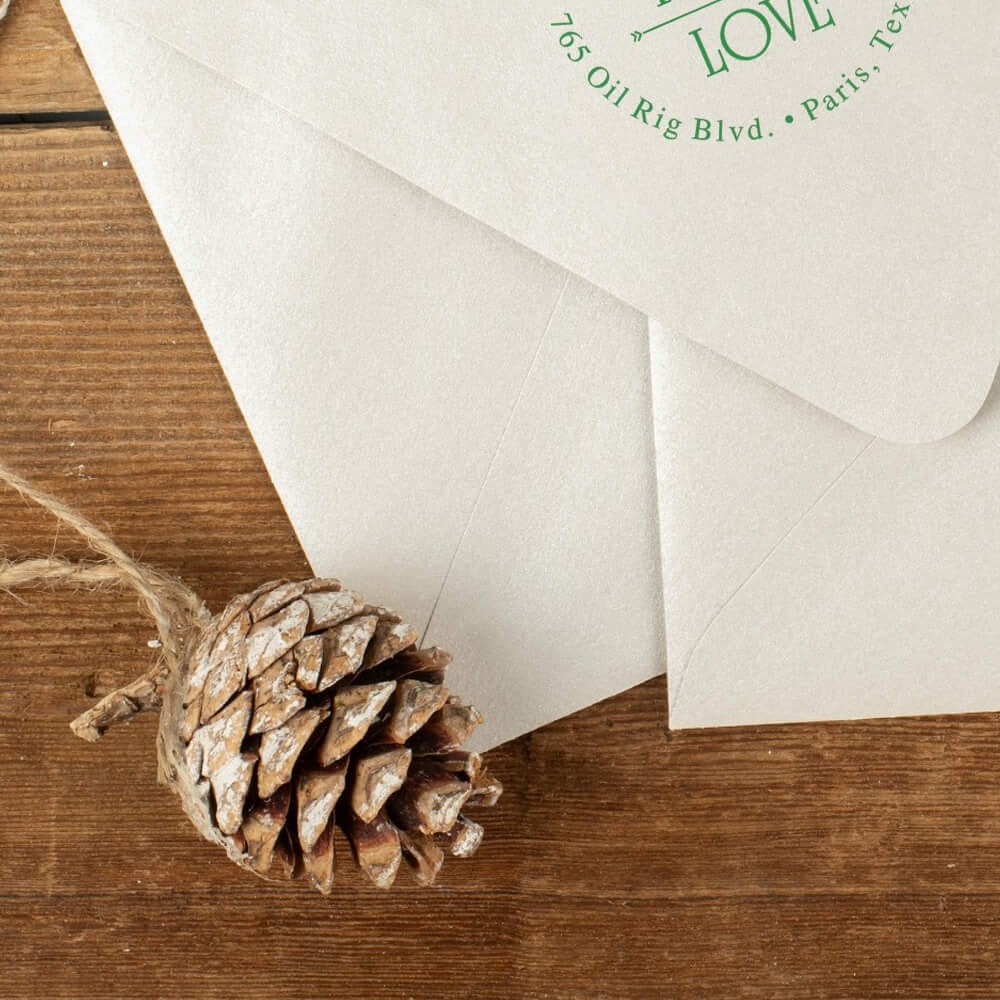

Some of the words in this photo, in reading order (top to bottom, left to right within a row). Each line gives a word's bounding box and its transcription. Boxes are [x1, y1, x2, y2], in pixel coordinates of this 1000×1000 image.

[550, 12, 592, 63] 765
[587, 65, 630, 107] Oil
[631, 96, 683, 141] Rig
[692, 117, 774, 142] Blvd.
[801, 63, 881, 121] Paris,
